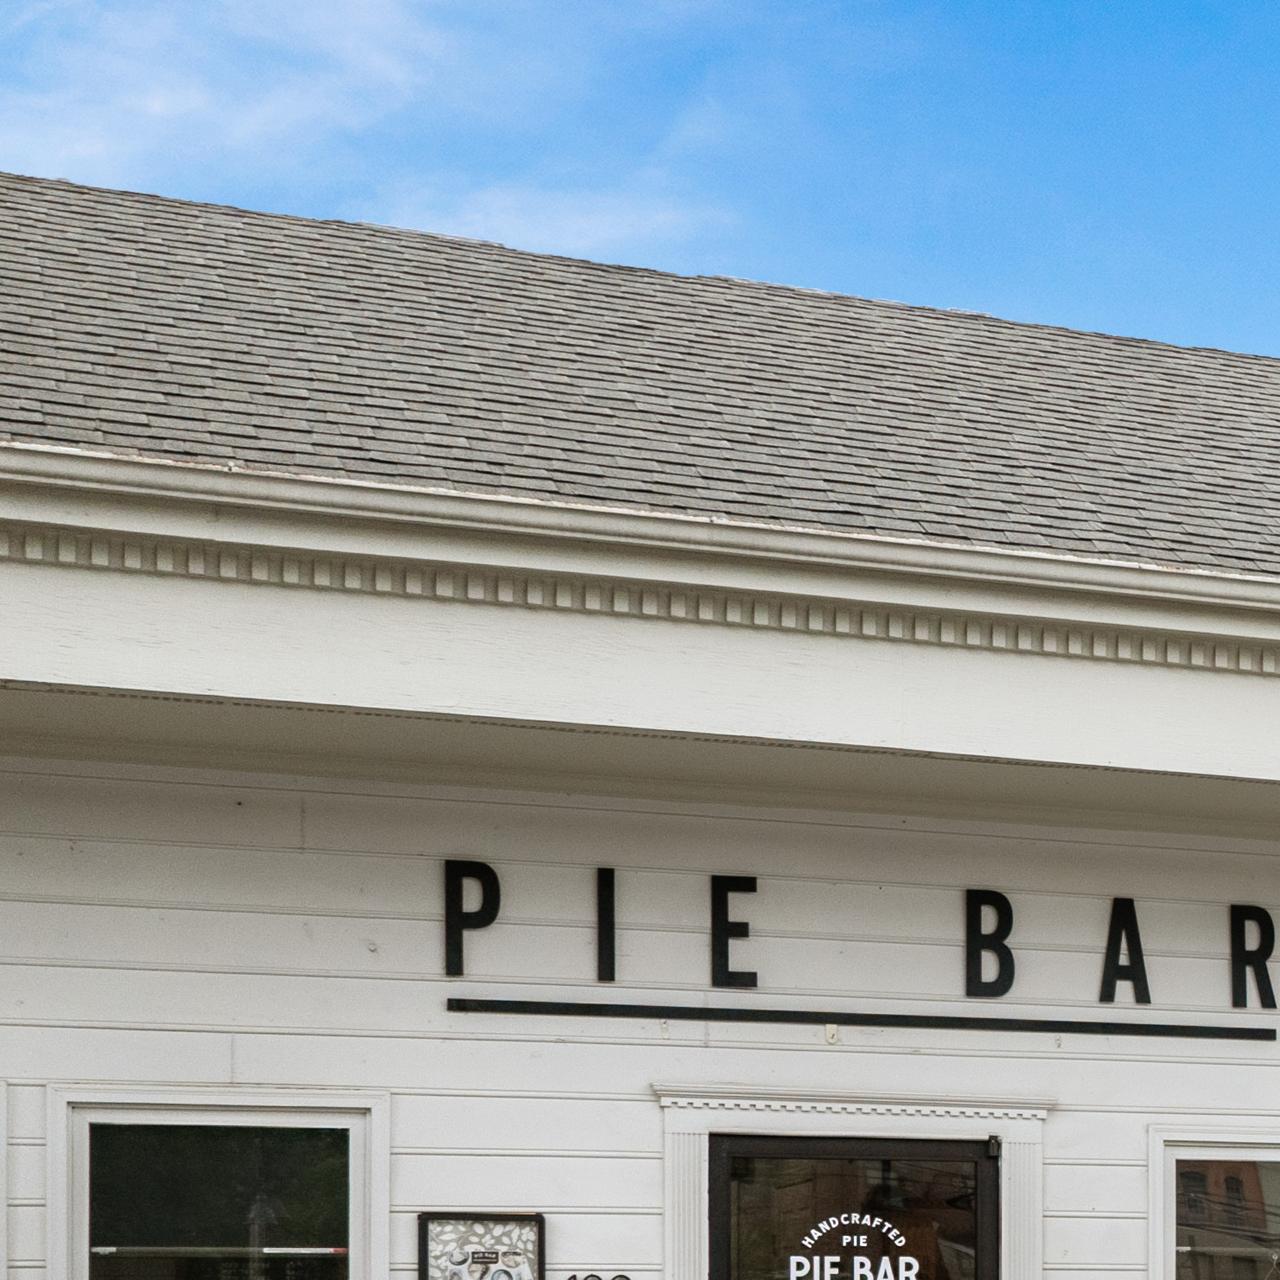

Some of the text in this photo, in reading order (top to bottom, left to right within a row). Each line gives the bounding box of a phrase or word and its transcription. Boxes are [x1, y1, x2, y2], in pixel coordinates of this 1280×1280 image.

[444, 859, 1278, 1009] PIE BAR
[801, 1213, 906, 1249] HANDCRAFTED
[842, 1235, 868, 1247] PIE
